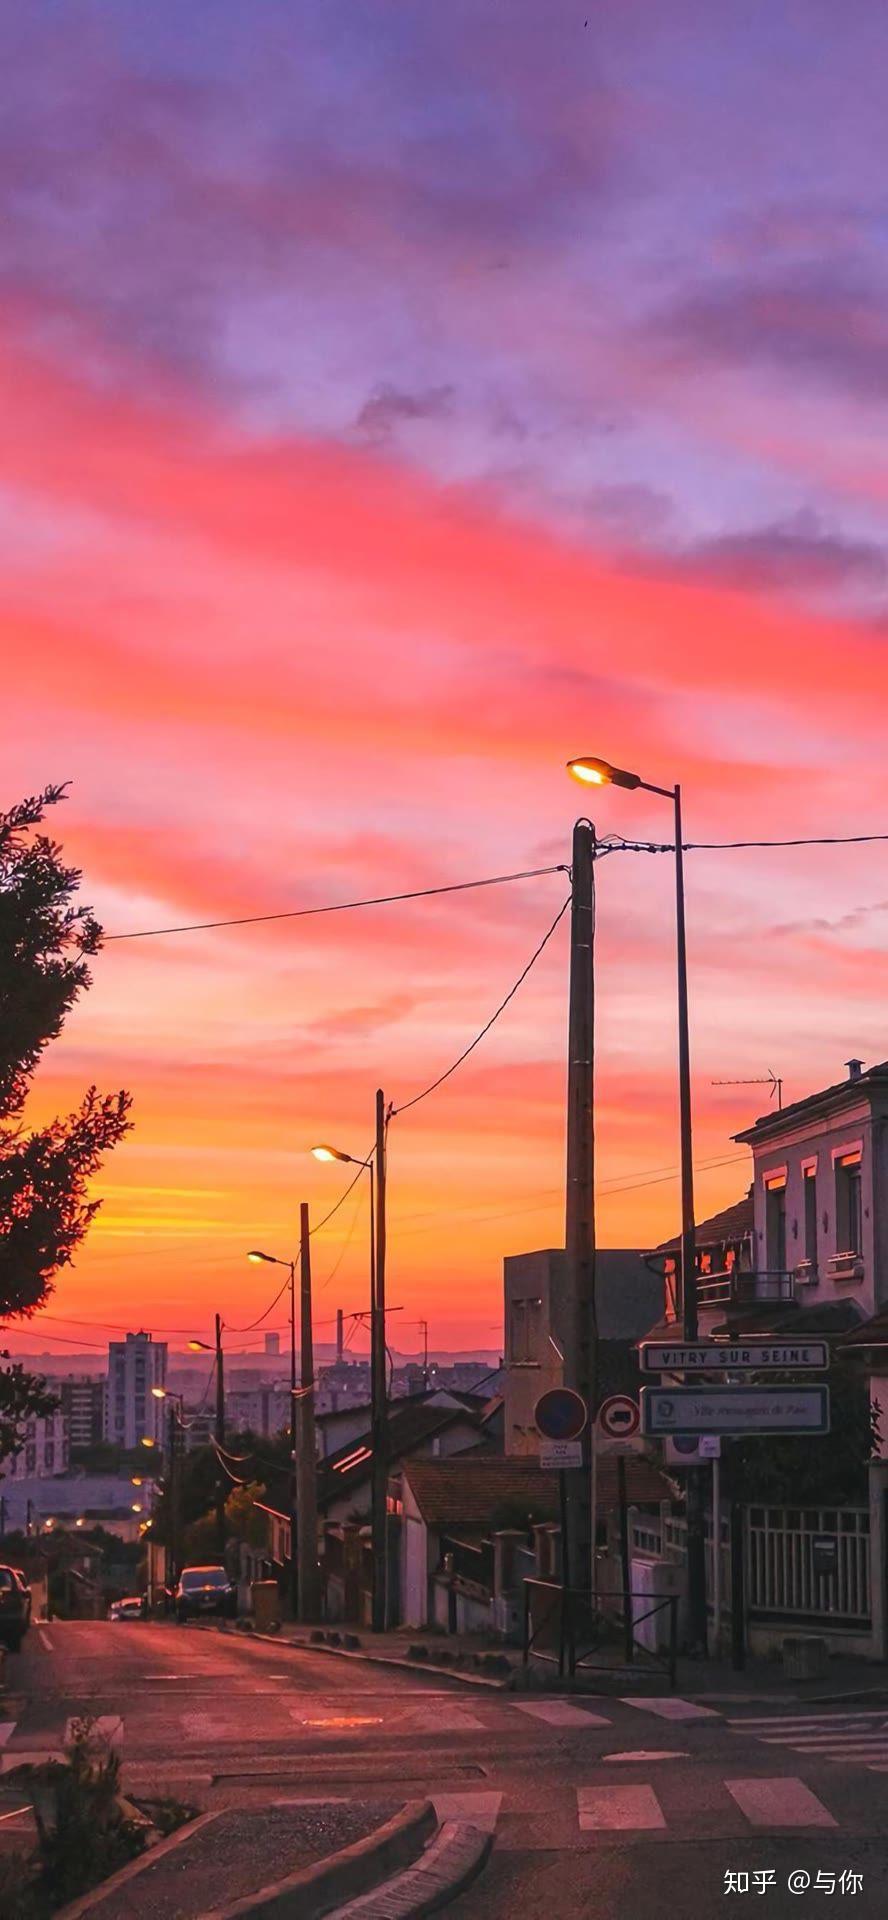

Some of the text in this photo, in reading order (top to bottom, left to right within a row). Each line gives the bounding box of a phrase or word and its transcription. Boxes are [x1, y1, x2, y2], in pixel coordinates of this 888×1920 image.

[662, 1349, 811, 1364] VITRY SUR SEINE
